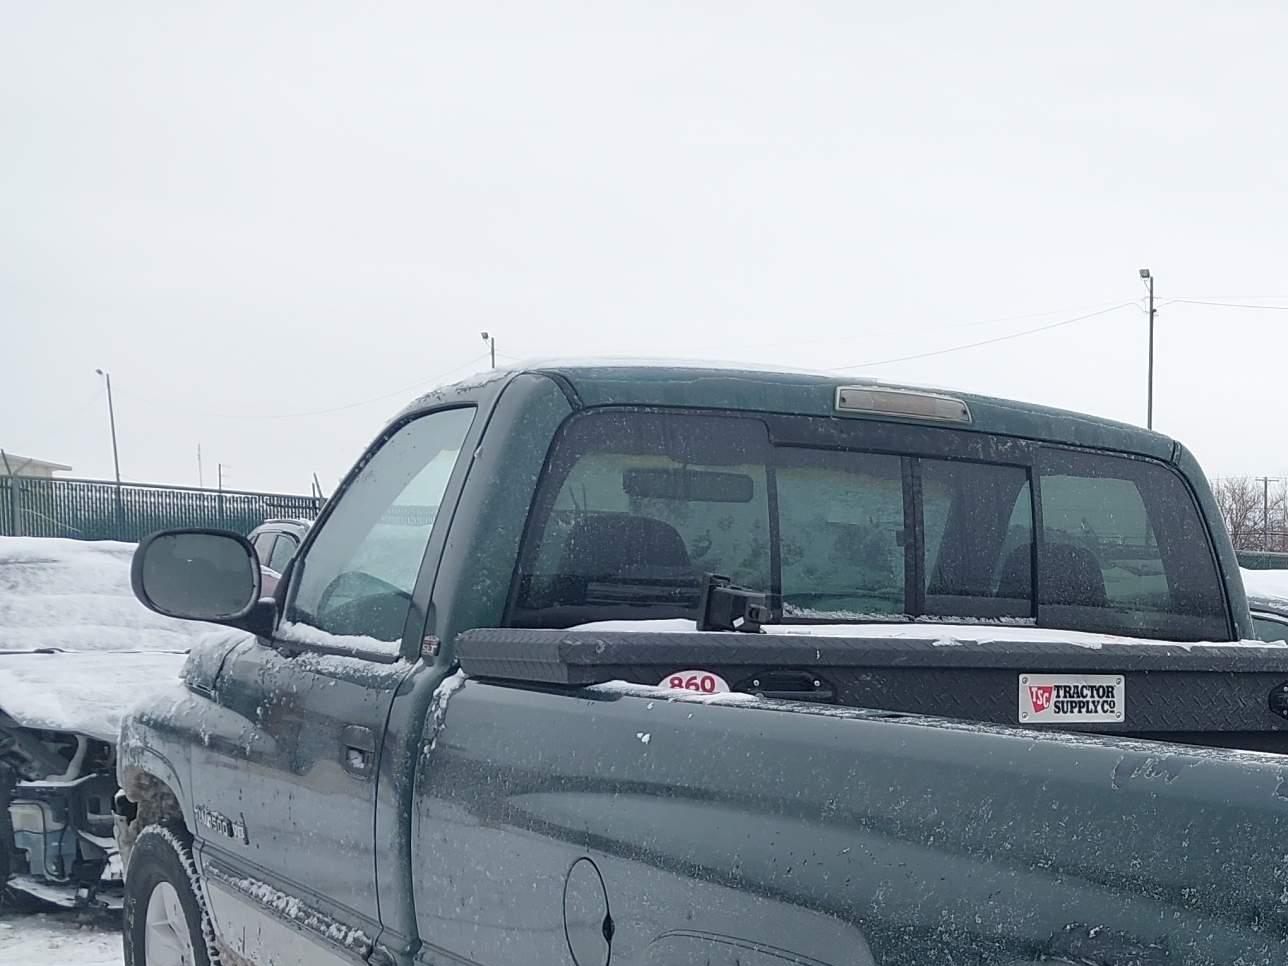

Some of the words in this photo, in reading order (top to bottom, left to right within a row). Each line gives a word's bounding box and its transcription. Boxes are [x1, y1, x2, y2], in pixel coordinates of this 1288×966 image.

[669, 675, 716, 693] 860
[1054, 684, 1115, 699] TRACTOR
[1031, 687, 1050, 708] TSC
[1053, 700, 1100, 714] SUPPLY
